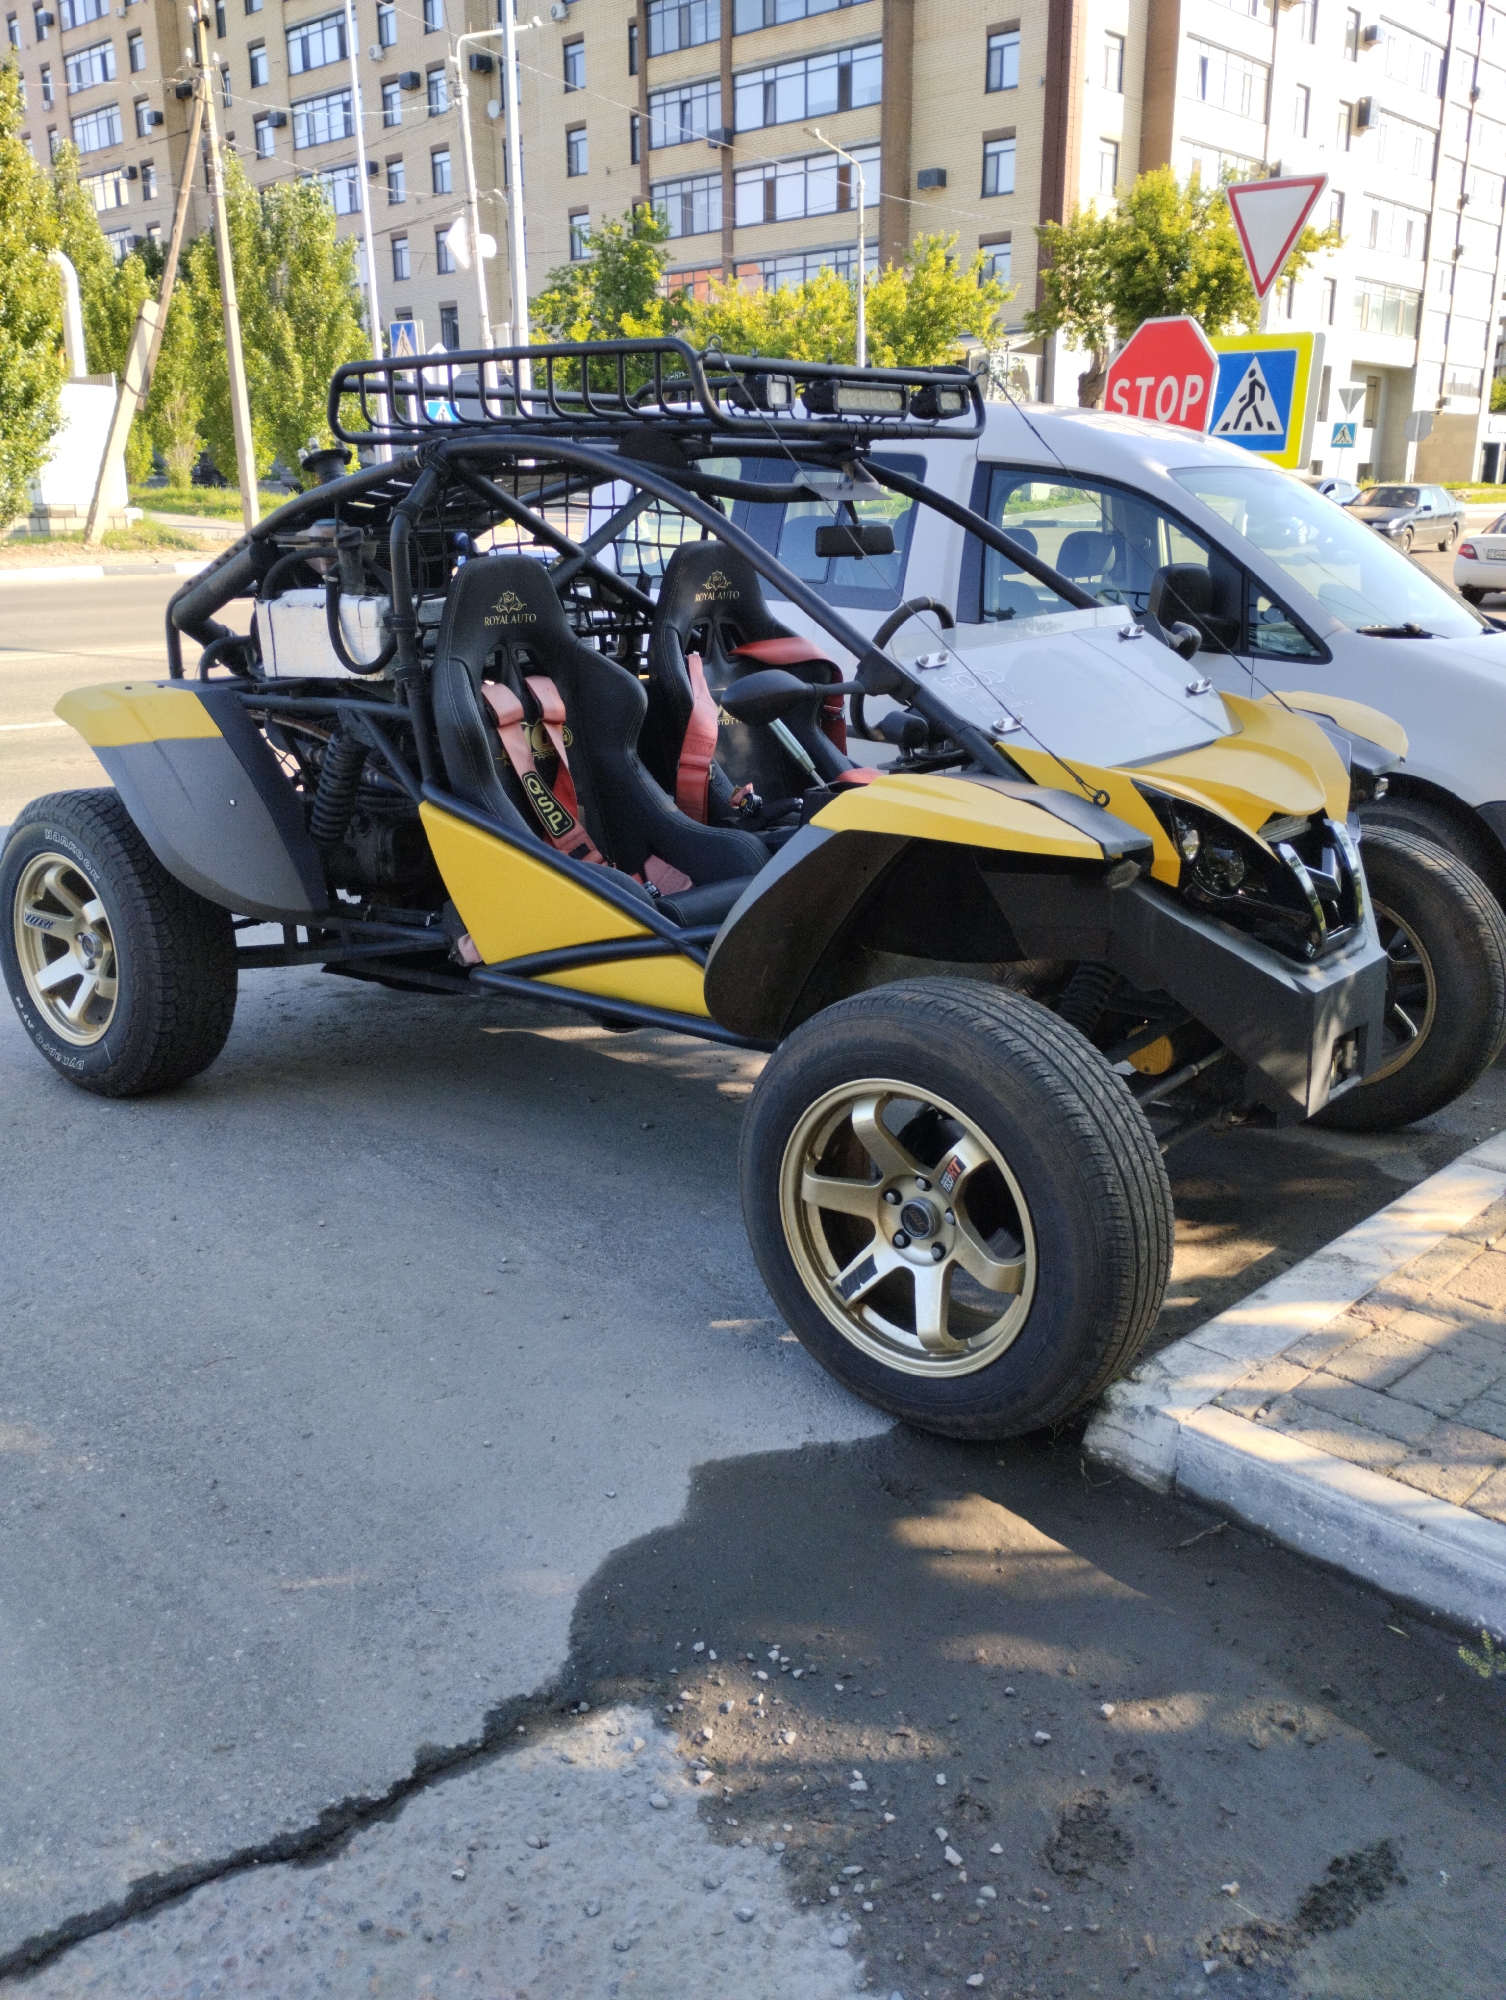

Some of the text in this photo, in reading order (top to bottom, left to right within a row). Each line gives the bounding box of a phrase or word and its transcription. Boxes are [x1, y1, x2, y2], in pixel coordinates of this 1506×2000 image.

[1112, 375, 1204, 422] STOP
[694, 591, 740, 602] ROYAL AUTO
[484, 613, 537, 627] ROYAL AUTO
[527, 777, 563, 832] QSP
